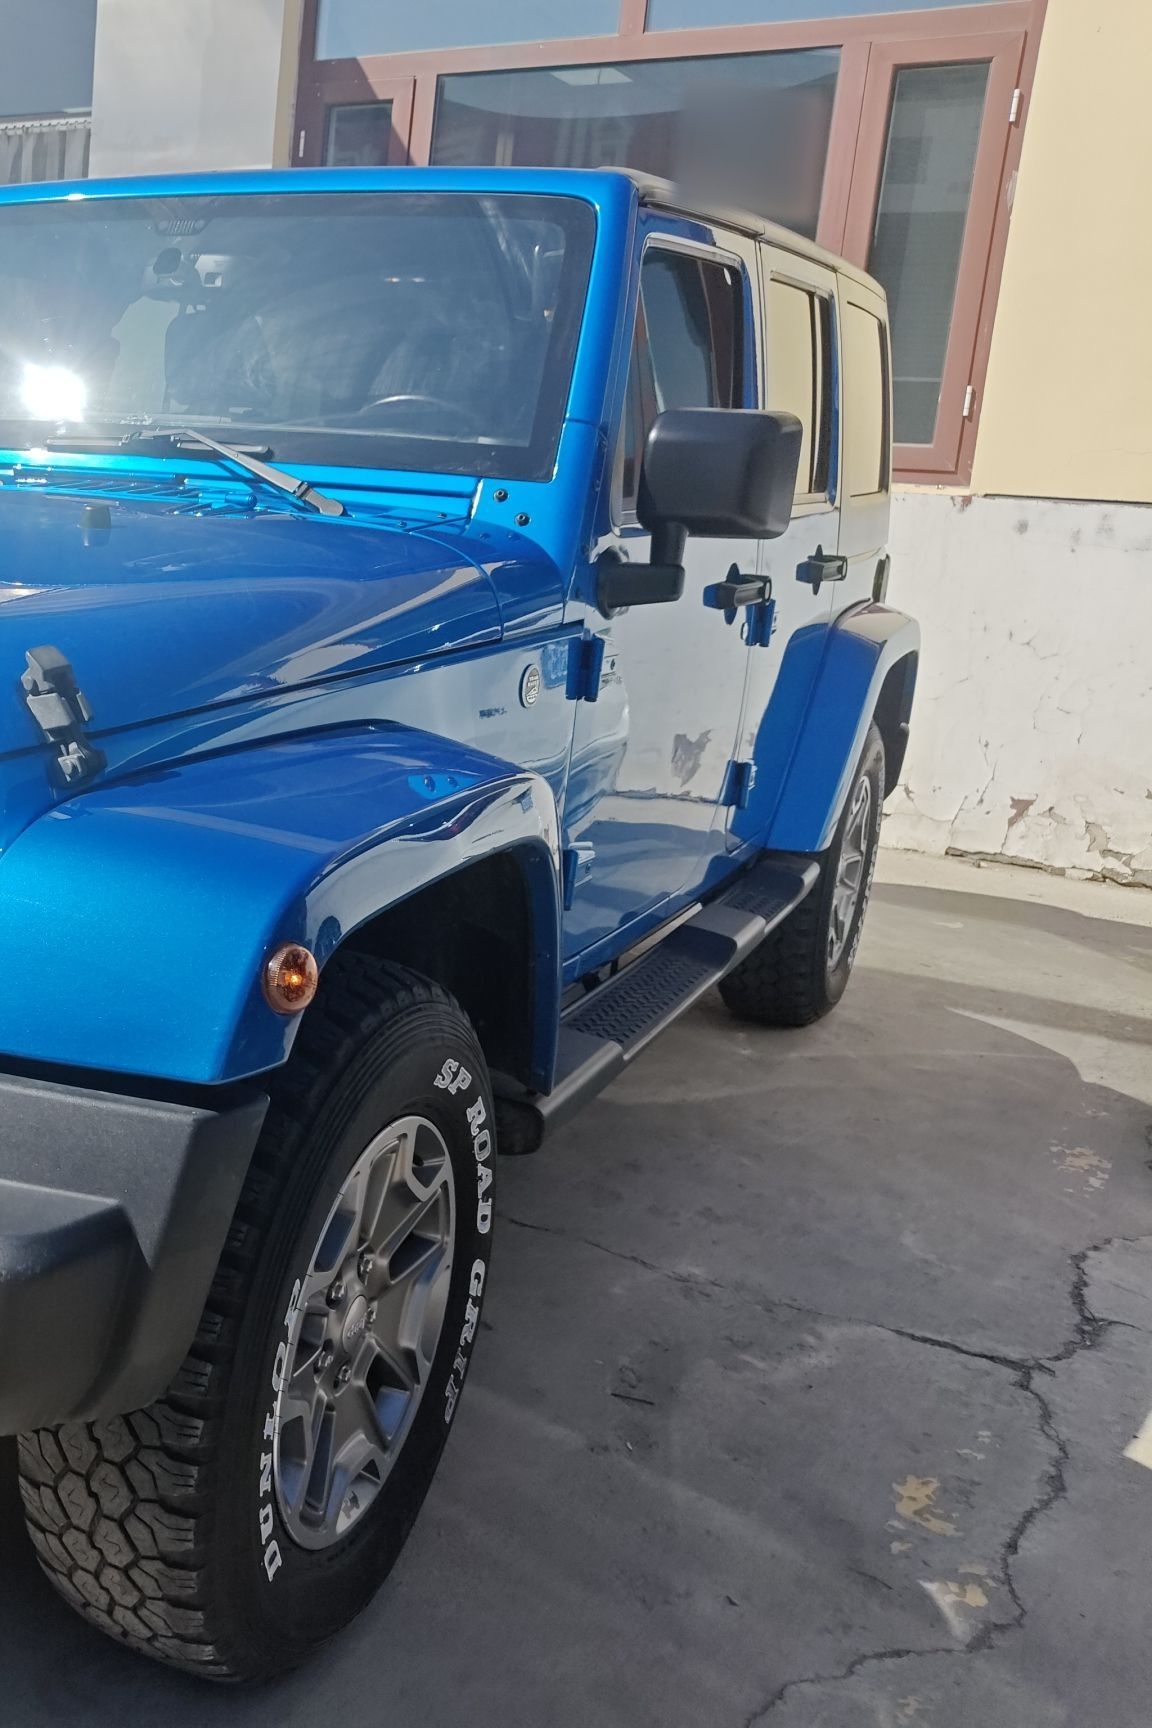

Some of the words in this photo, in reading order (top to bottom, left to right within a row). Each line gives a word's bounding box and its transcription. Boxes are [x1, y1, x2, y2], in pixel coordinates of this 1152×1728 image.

[433, 1058, 472, 1095] SP
[466, 1096, 493, 1234] ROAD
[444, 1258, 486, 1424] GRIP
